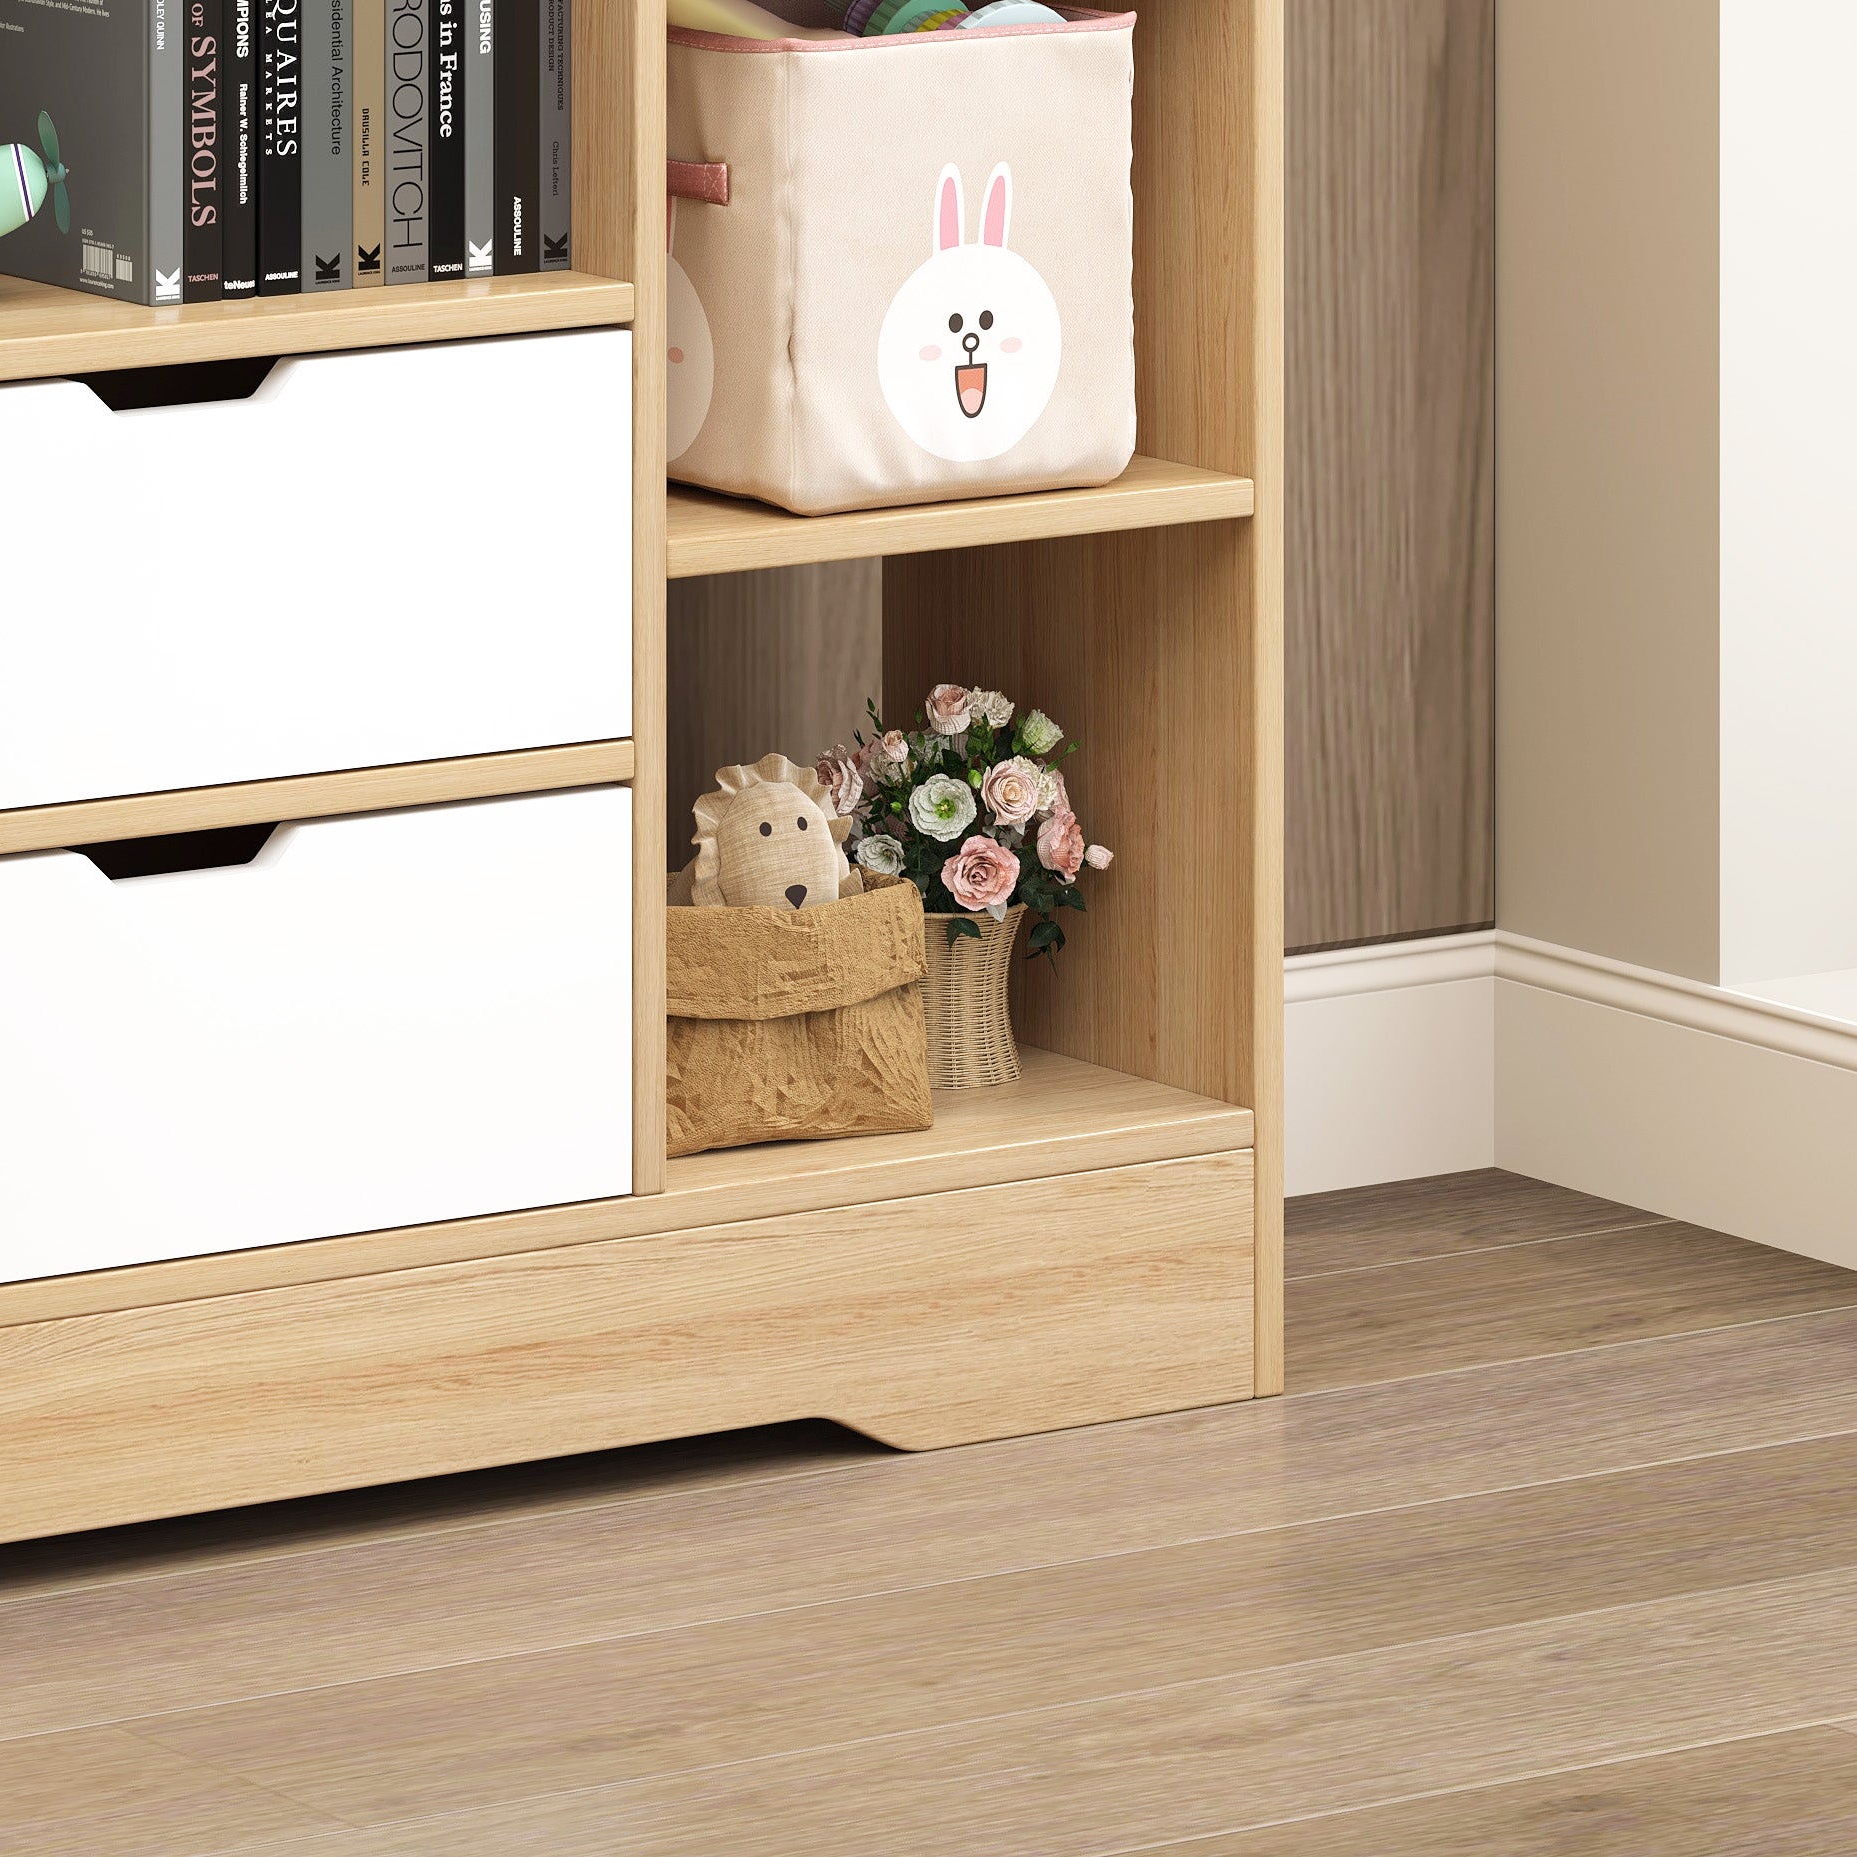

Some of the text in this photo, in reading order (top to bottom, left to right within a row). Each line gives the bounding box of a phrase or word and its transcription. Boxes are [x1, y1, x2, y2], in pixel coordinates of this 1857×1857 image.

[191, 3, 204, 28] OF
[439, 21, 458, 47] in
[331, 66, 344, 155] Architecture
[439, 52, 458, 137] France
[191, 37, 217, 226] SYMBOLS
[361, 108, 370, 186] DRUSILLA COLE
[513, 196, 522, 256] ASSOULINE
[432, 262, 463, 273] TASCHEN
